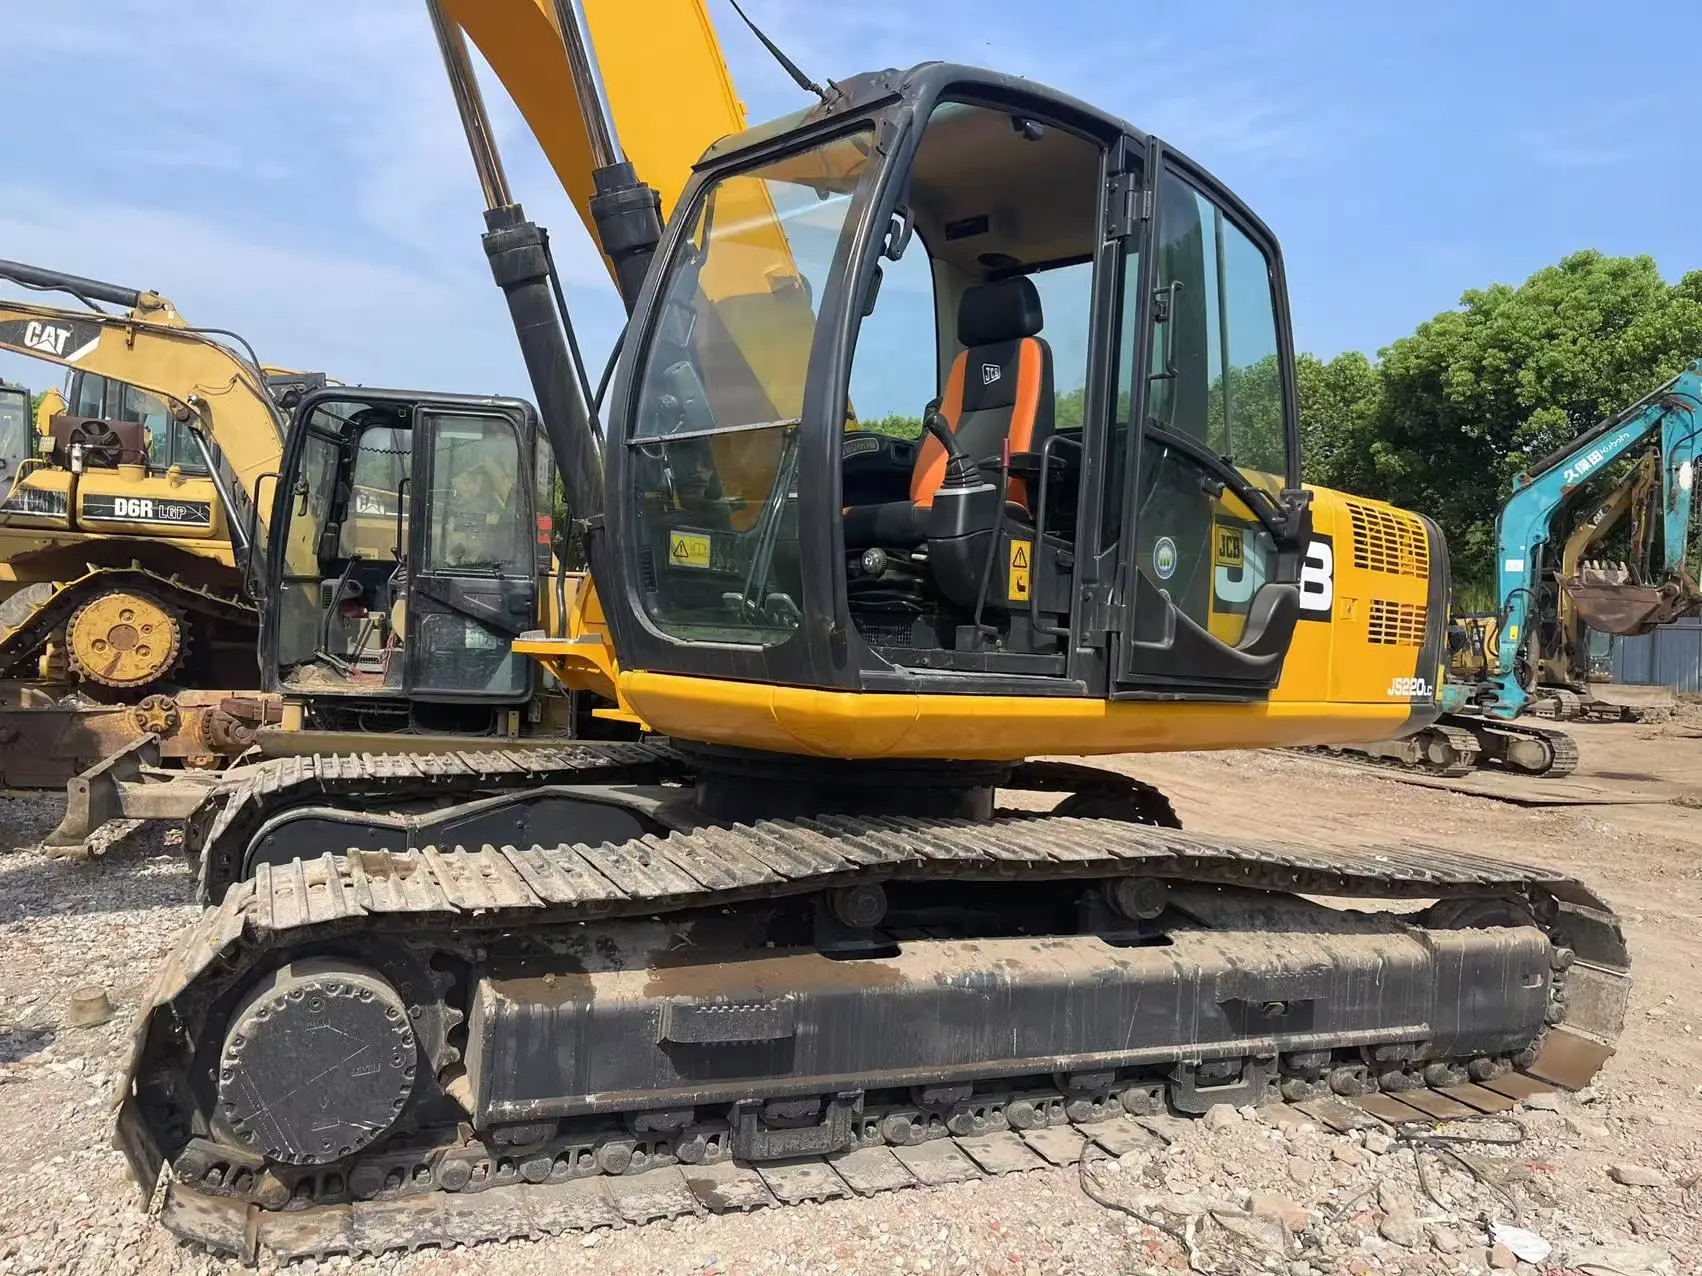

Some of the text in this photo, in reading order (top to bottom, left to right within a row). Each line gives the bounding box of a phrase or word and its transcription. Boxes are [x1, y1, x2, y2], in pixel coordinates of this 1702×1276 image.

[24, 321, 71, 356] CAT
[984, 366, 1000, 382] JCB
[1563, 449, 1604, 483] 久保田
[114, 498, 187, 520] D6R LGP
[1219, 533, 1241, 560] JCB
